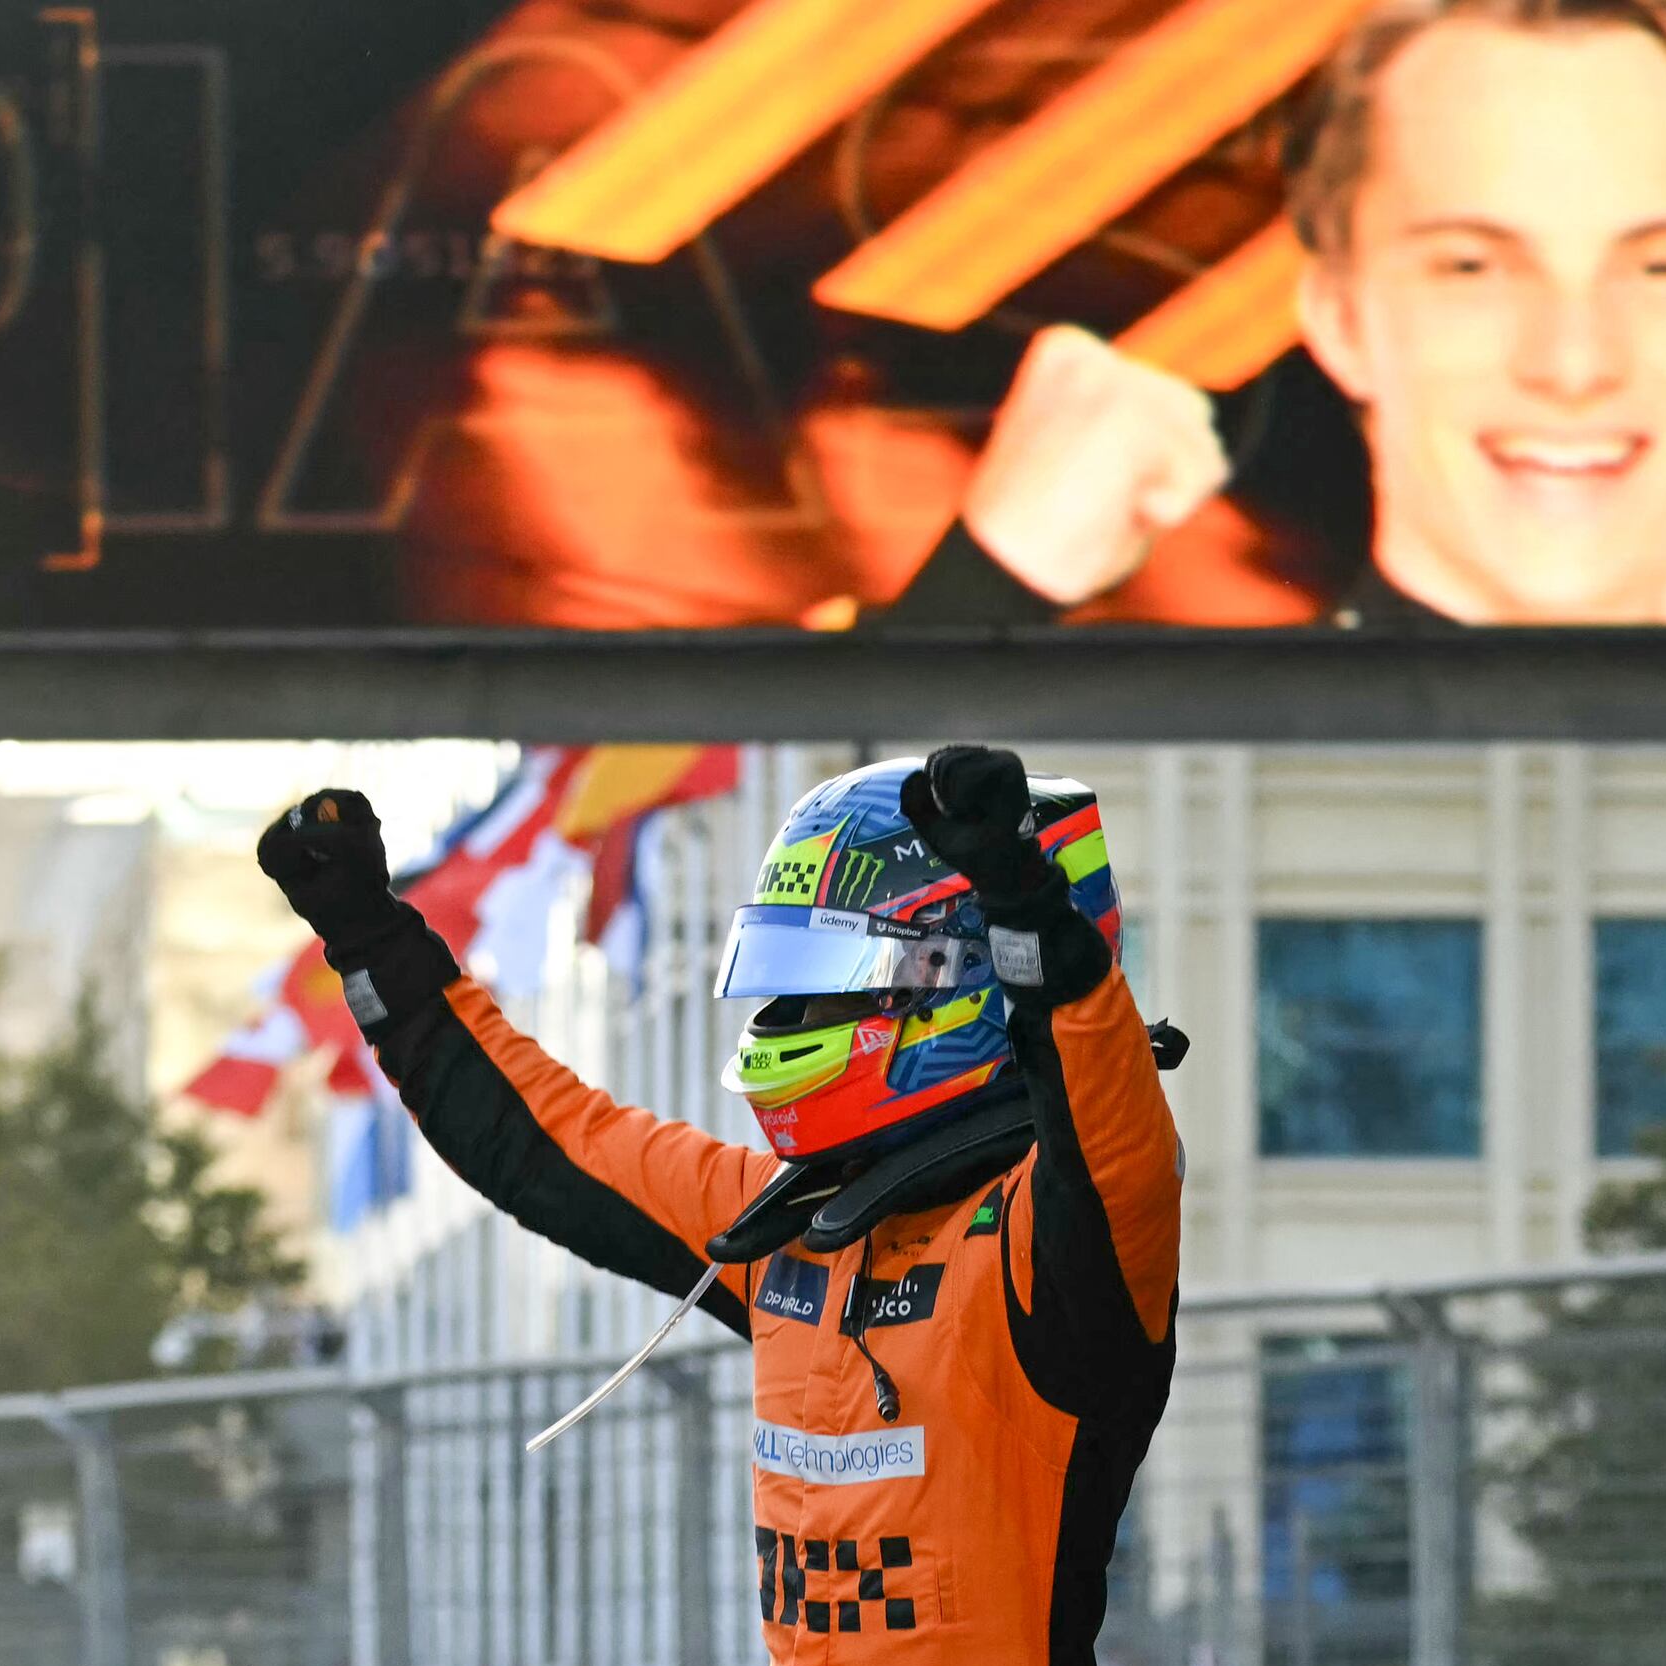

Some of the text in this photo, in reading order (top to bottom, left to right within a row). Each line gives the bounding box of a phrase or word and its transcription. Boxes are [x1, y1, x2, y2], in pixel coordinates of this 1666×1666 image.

[887, 924, 922, 938] Dropbox
[764, 1290, 813, 1316] DP WRLD
[783, 1432, 914, 1477] Tehnologies
